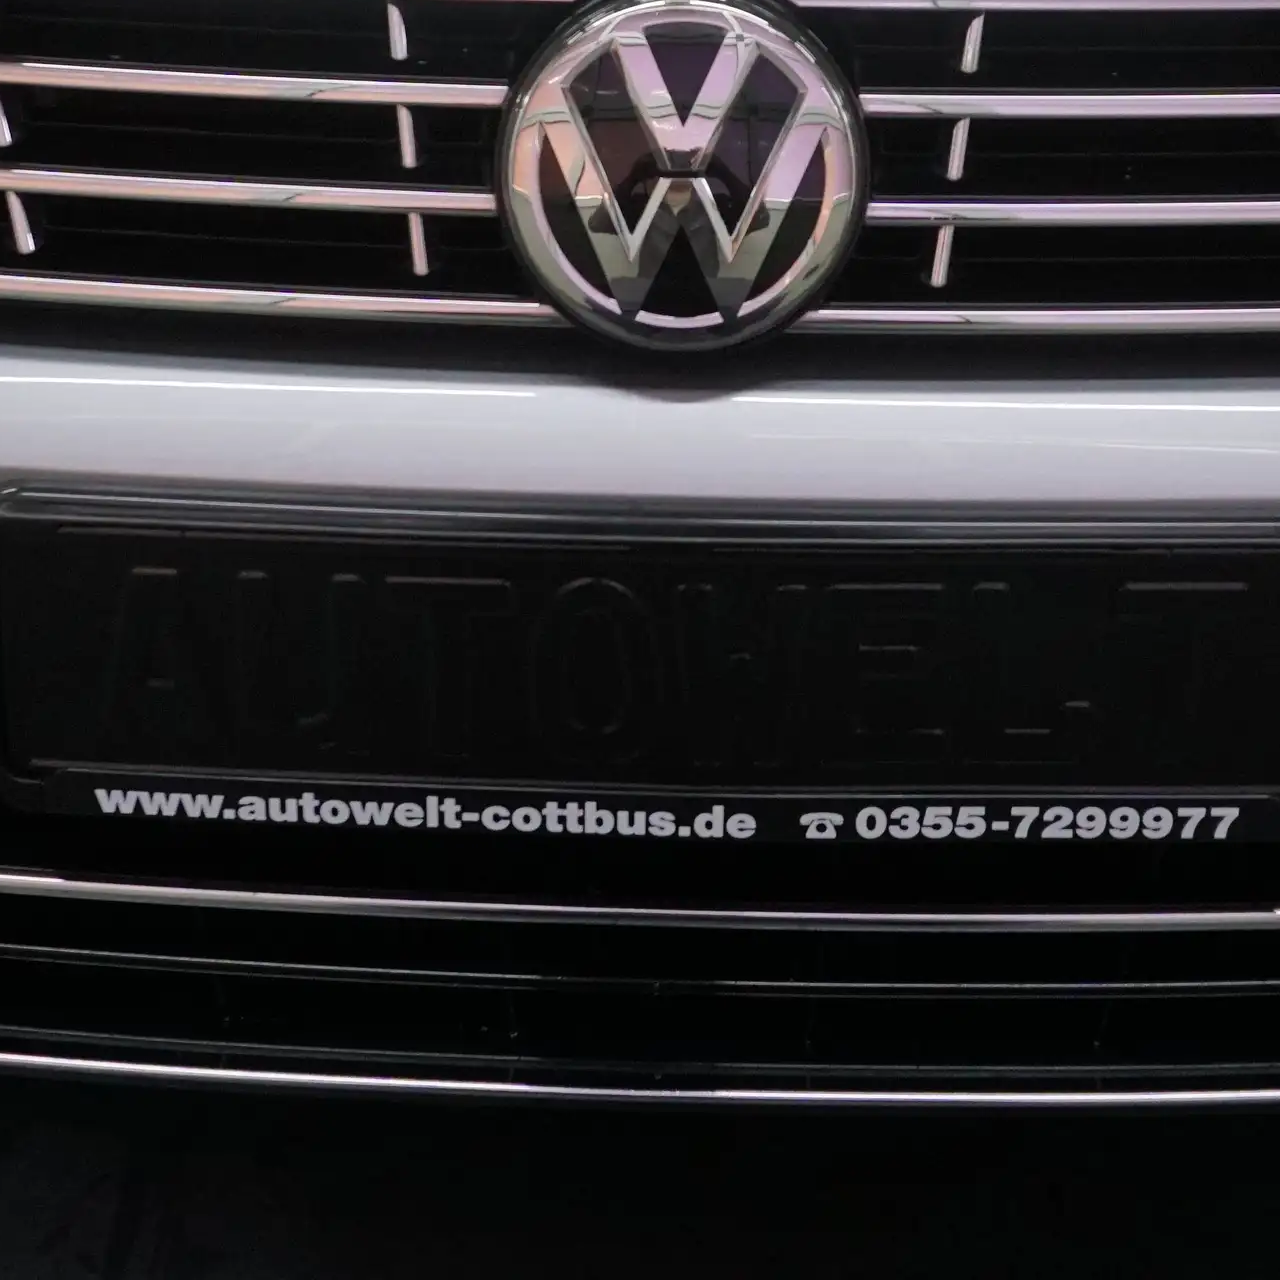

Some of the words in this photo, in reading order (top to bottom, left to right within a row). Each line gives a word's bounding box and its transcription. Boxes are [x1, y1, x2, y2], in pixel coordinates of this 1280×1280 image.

[98, 565, 1252, 766] AUTOWELT
[94, 787, 757, 839] www.autowelt-cottbus.de
[855, 805, 1241, 840] 0355-7299977
